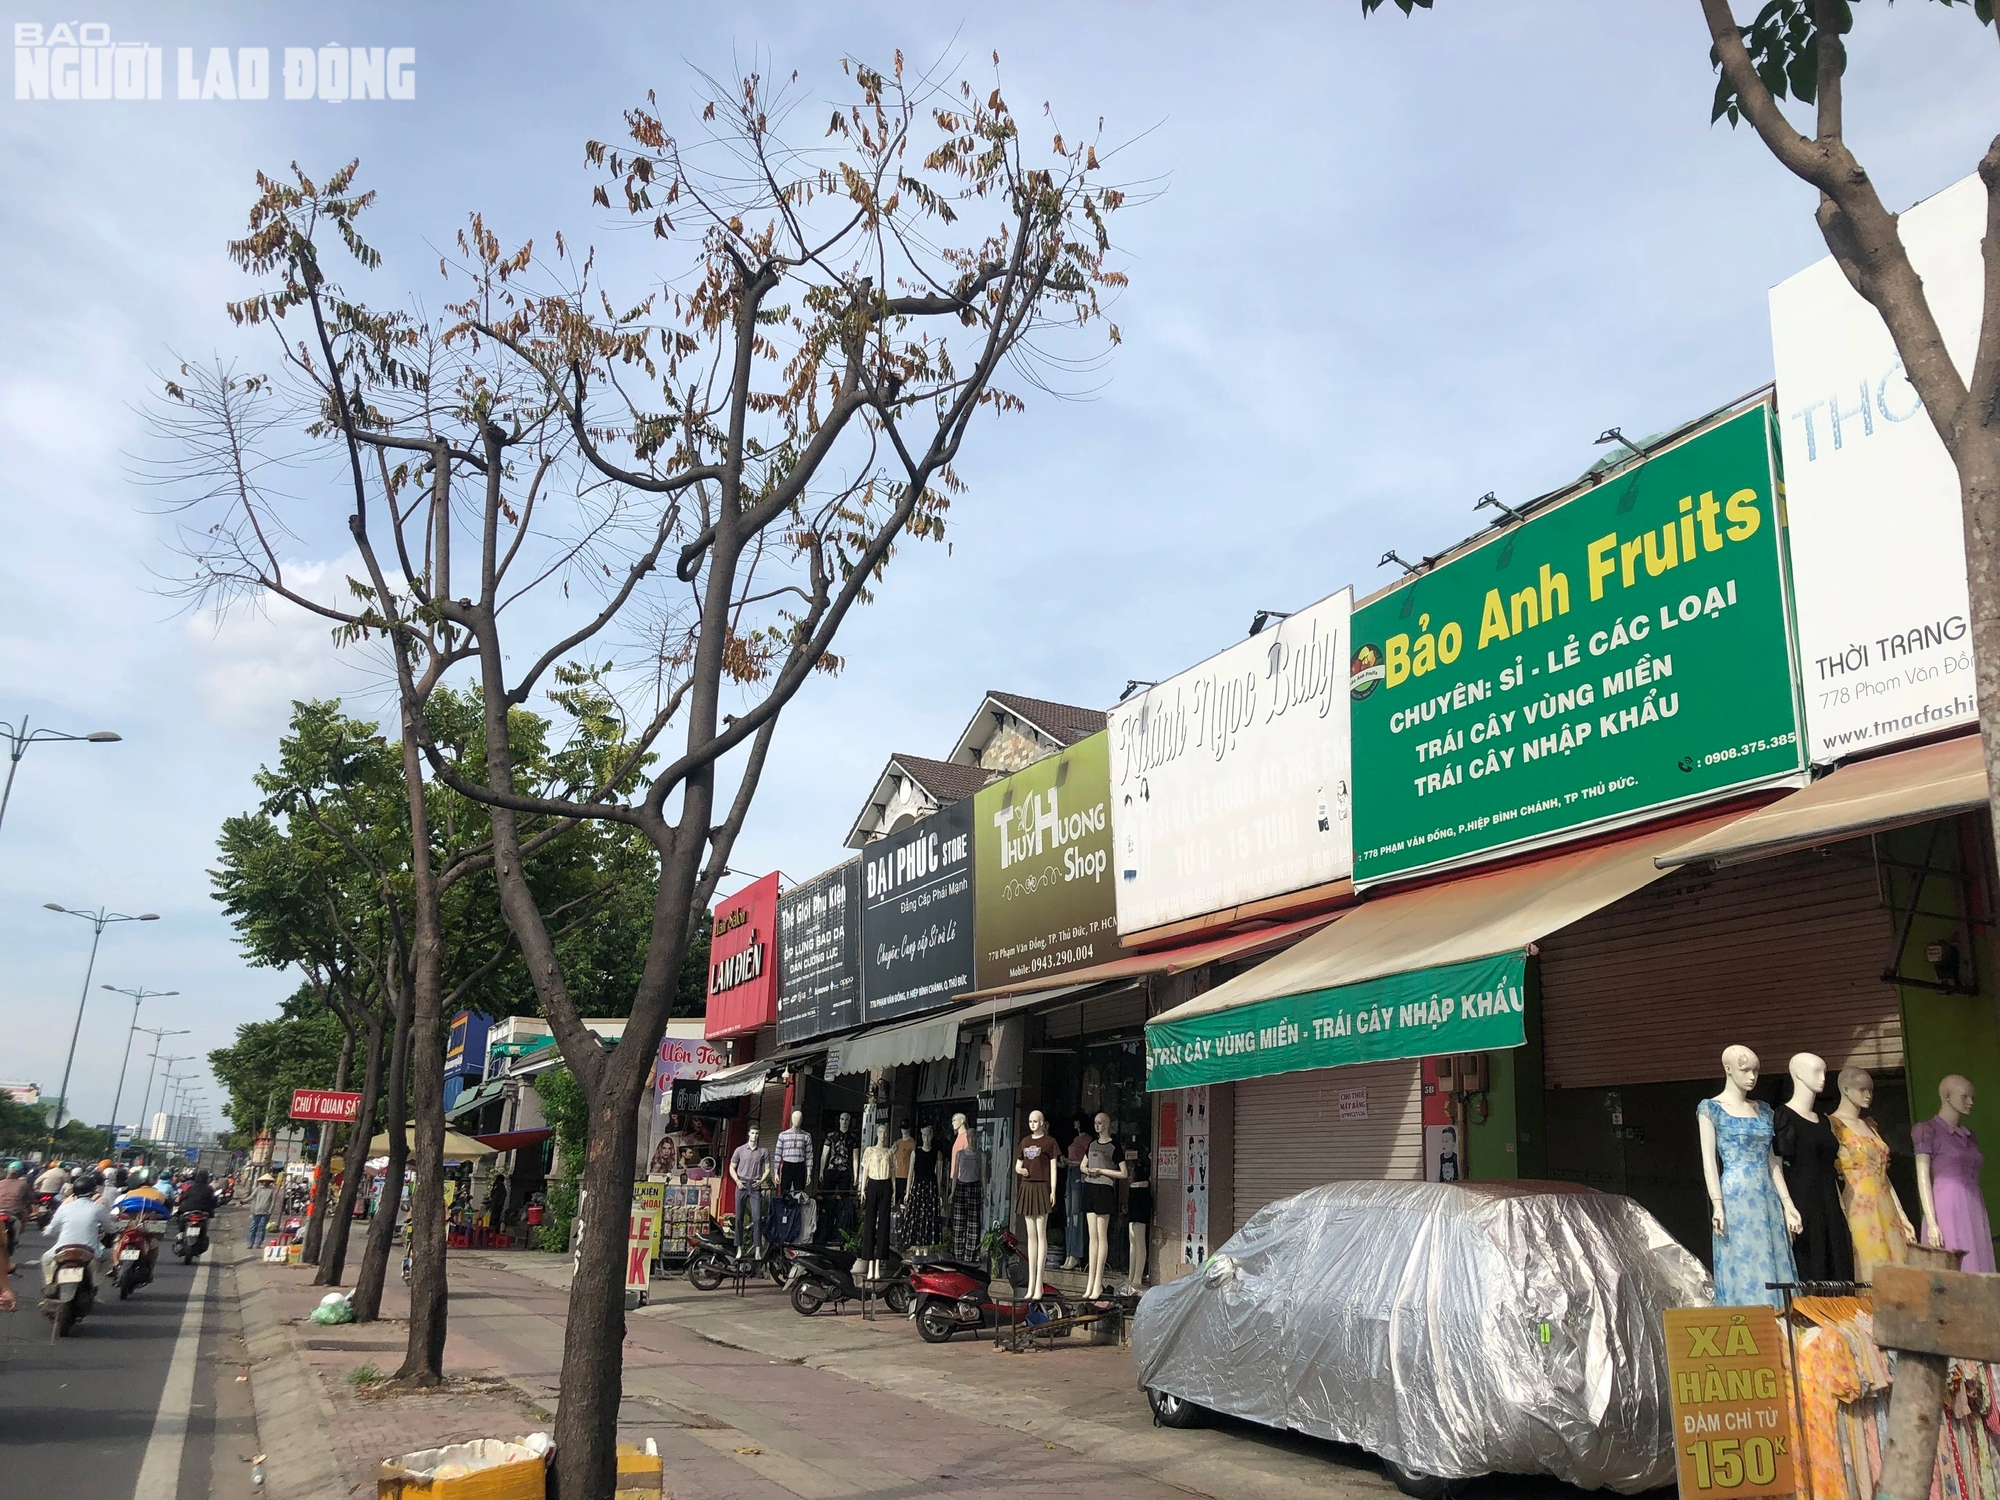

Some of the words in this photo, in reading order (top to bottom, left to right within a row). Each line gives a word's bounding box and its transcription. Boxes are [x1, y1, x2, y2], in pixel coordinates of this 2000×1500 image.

[1386, 613, 1462, 689] Bảo
[1478, 563, 1570, 651] Anh
[1587, 488, 1761, 601] Fruits
[1390, 679, 1492, 734] CHUYÊN:
[1499, 655, 1524, 692] SỈ
[1547, 634, 1580, 674] LẺ
[1588, 615, 1650, 657] CÁC
[1660, 579, 1737, 631] LOẠI
[1815, 643, 1869, 680] THỜI
[1875, 615, 1966, 662] TRANG
[1265, 617, 1338, 725] Baby
[1819, 687, 1850, 709] 778
[1855, 676, 1900, 700] Phạm
[1904, 666, 1939, 685] Văn
[1415, 729, 1463, 764] TRÁI
[1470, 710, 1516, 744] CÂY
[1524, 683, 1594, 725] VÙNG
[1602, 653, 1673, 700] MIỀN
[1414, 762, 1462, 797] TRÁI
[1468, 746, 1515, 779] CÂY
[1522, 721, 1592, 760] NHẬP
[1600, 687, 1680, 738] KHẨU
[1704, 732, 1797, 766] 0908.375.385
[1364, 849, 1379, 860] 778
[1380, 841, 1405, 855] PHẠM
[1406, 835, 1425, 848] VĂN
[1458, 816, 1490, 834] P.HIỆP
[1492, 809, 1518, 825] BÌNH
[1520, 798, 1562, 817] CHÁNH,
[1563, 792, 1579, 805] TP
[1581, 780, 1606, 800] THỦ
[1608, 776, 1639, 793] ĐỨC.
[867, 852, 893, 901] ĐẠI
[896, 829, 939, 886] PHÚC
[942, 833, 968, 867] STORE
[1064, 846, 1107, 884] Shop
[917, 890, 932, 907] Cấp
[932, 886, 948, 900] Phái
[948, 877, 968, 896] Mạnh
[816, 930, 832, 948] BAO
[833, 925, 845, 940] DA
[988, 952, 999, 962] 778
[999, 944, 1016, 959] Phạm
[1048, 933, 1058, 945] TP.
[1058, 928, 1071, 942] Thủ
[1072, 925, 1088, 938] Đức,
[1089, 920, 1100, 934] TP.
[1009, 965, 1031, 978] Mobile:
[1031, 943, 1094, 973] 0943.290.004
[1152, 1040, 1182, 1066] TRÁI
[1184, 1036, 1211, 1062] CÂY
[1214, 1030, 1256, 1058] VÙNG
[1260, 1017, 1299, 1050] MIỀN
[1312, 1009, 1351, 1041] TRÁI
[1356, 1003, 1394, 1035] CÂY
[1399, 993, 1454, 1030] NHẬP
[1461, 975, 1524, 1019] KHẨU
[661, 1041, 693, 1063] Uốn
[695, 1045, 723, 1065] Tóc
[294, 1094, 313, 1112] CHÚ
[313, 1094, 321, 1113] Ý
[320, 1098, 345, 1114] QUAN
[1685, 1314, 1760, 1358] XẢ
[1676, 1364, 1777, 1404] HÀNG
[1755, 1406, 1779, 1428] TỪ
